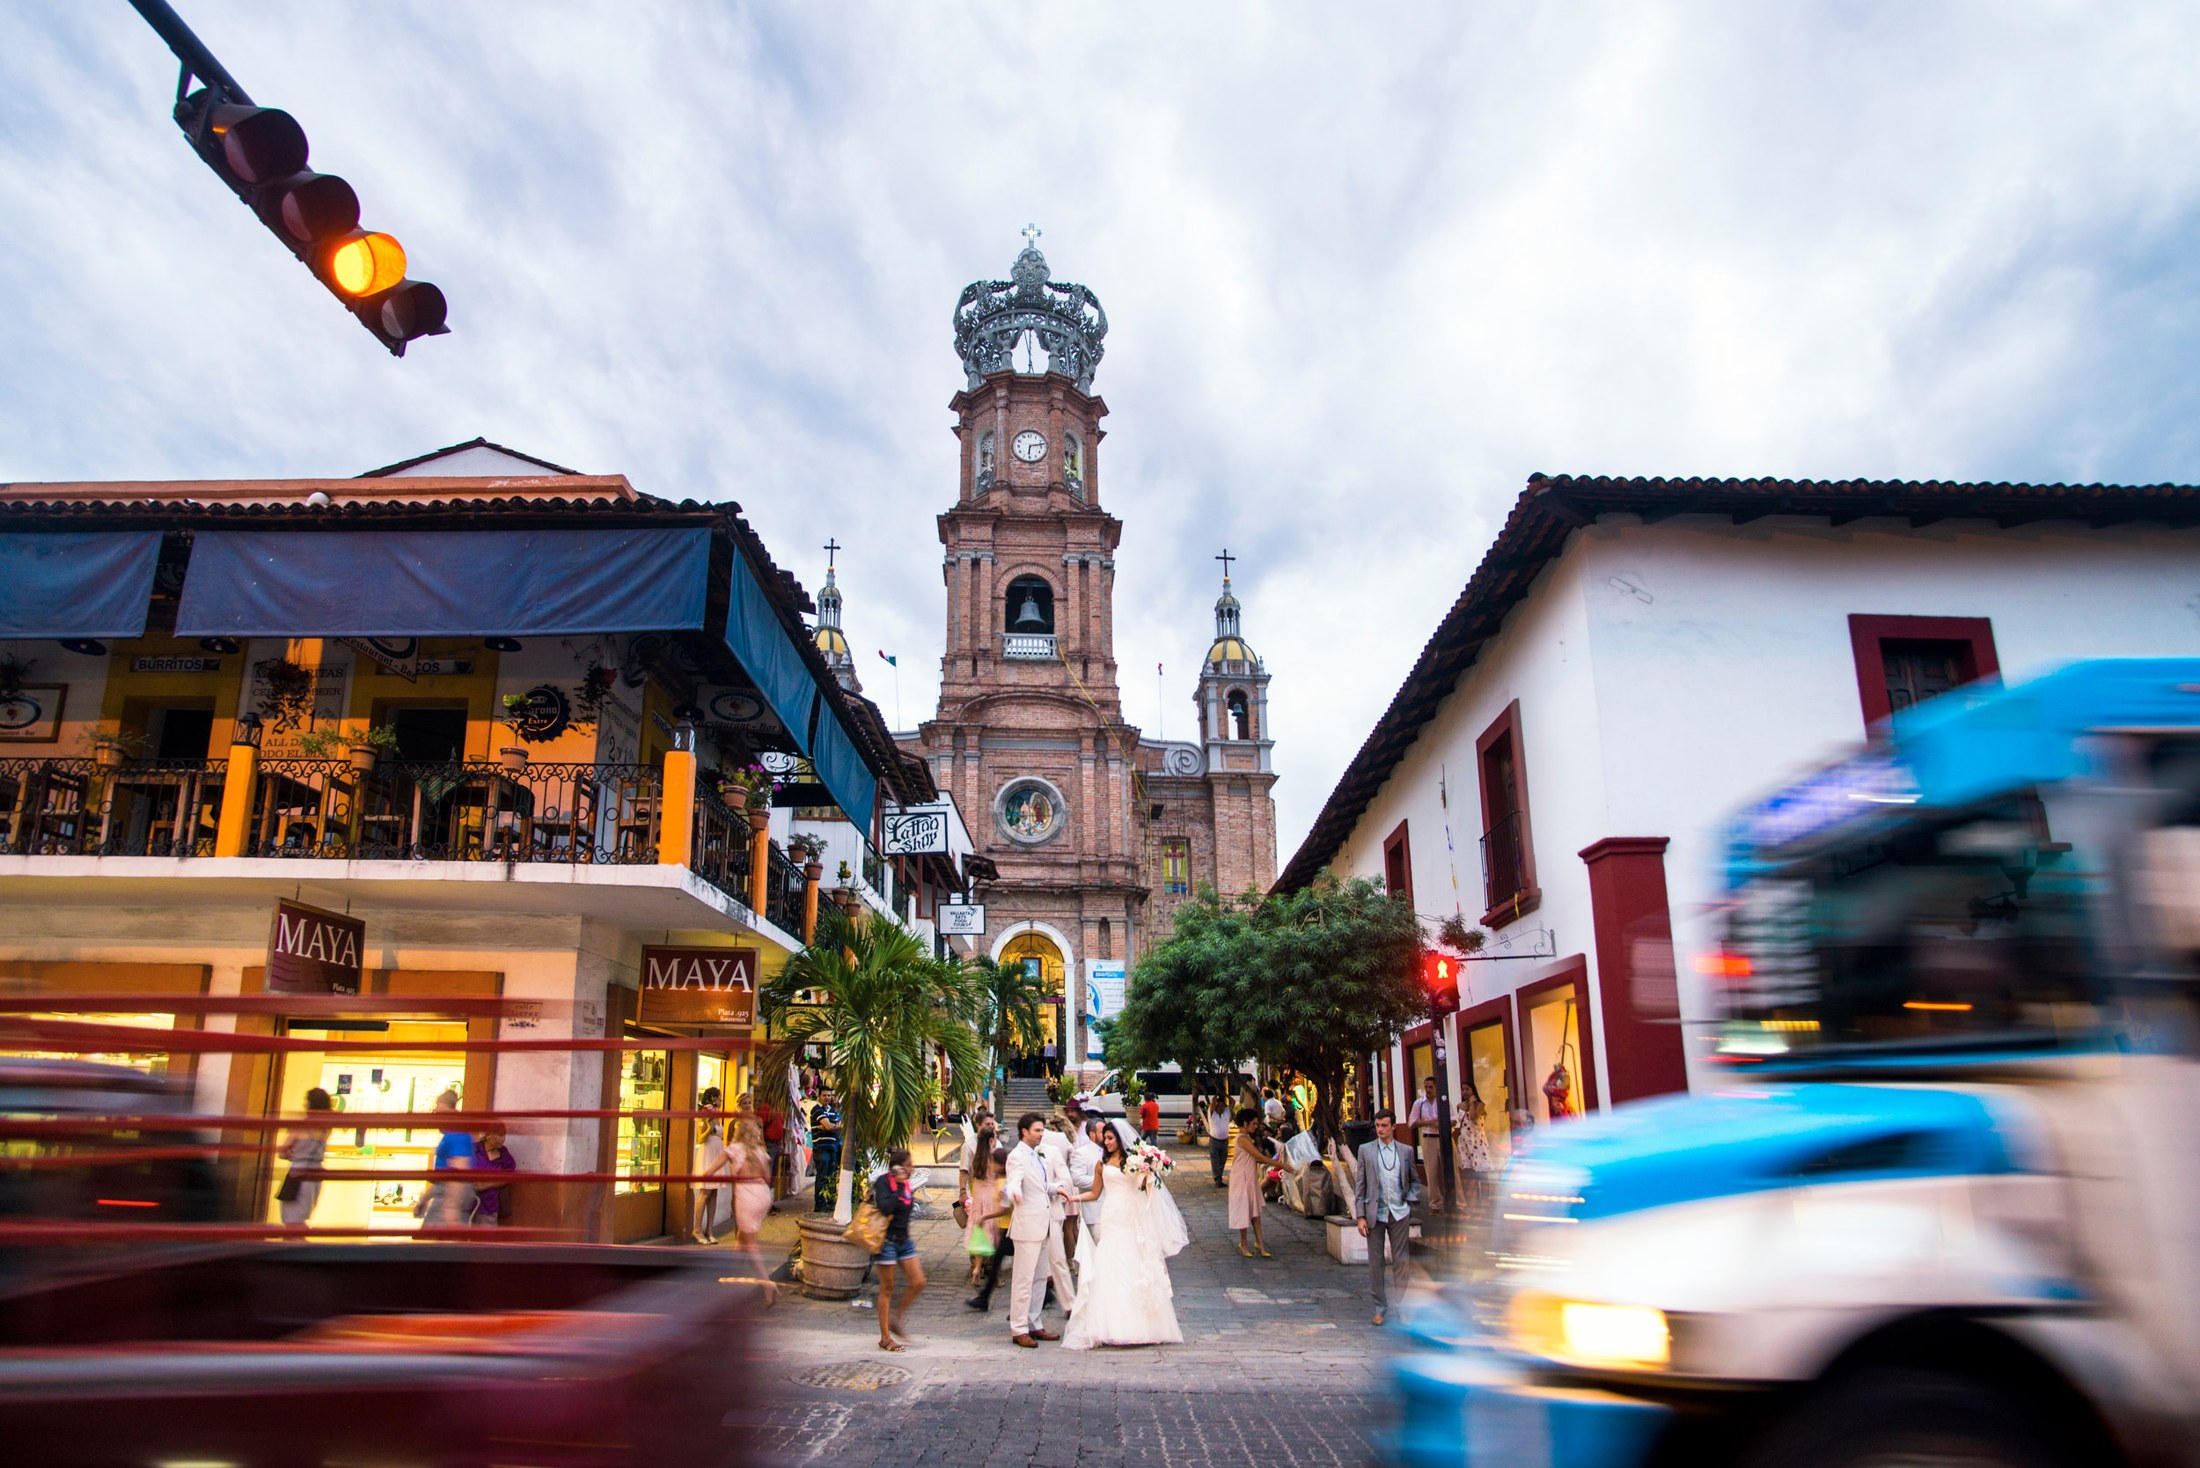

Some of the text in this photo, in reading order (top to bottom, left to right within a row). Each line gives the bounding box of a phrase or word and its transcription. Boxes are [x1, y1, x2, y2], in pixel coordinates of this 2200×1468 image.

[138, 658, 203, 671] BURRITOS
[416, 661, 441, 674] COS
[400, 664, 417, 681] Bar
[527, 706, 558, 717] orona
[698, 719, 750, 731] Restaurant
[759, 722, 778, 732] Bar
[265, 738, 288, 747] ALL
[258, 749, 284, 759] ODO
[286, 749, 302, 759] EL
[885, 814, 940, 851] Tattoo
[275, 912, 359, 969] MAYA
[645, 957, 753, 993] MAYA
[332, 982, 345, 992] Plata
[718, 1008, 734, 1016] Plata
